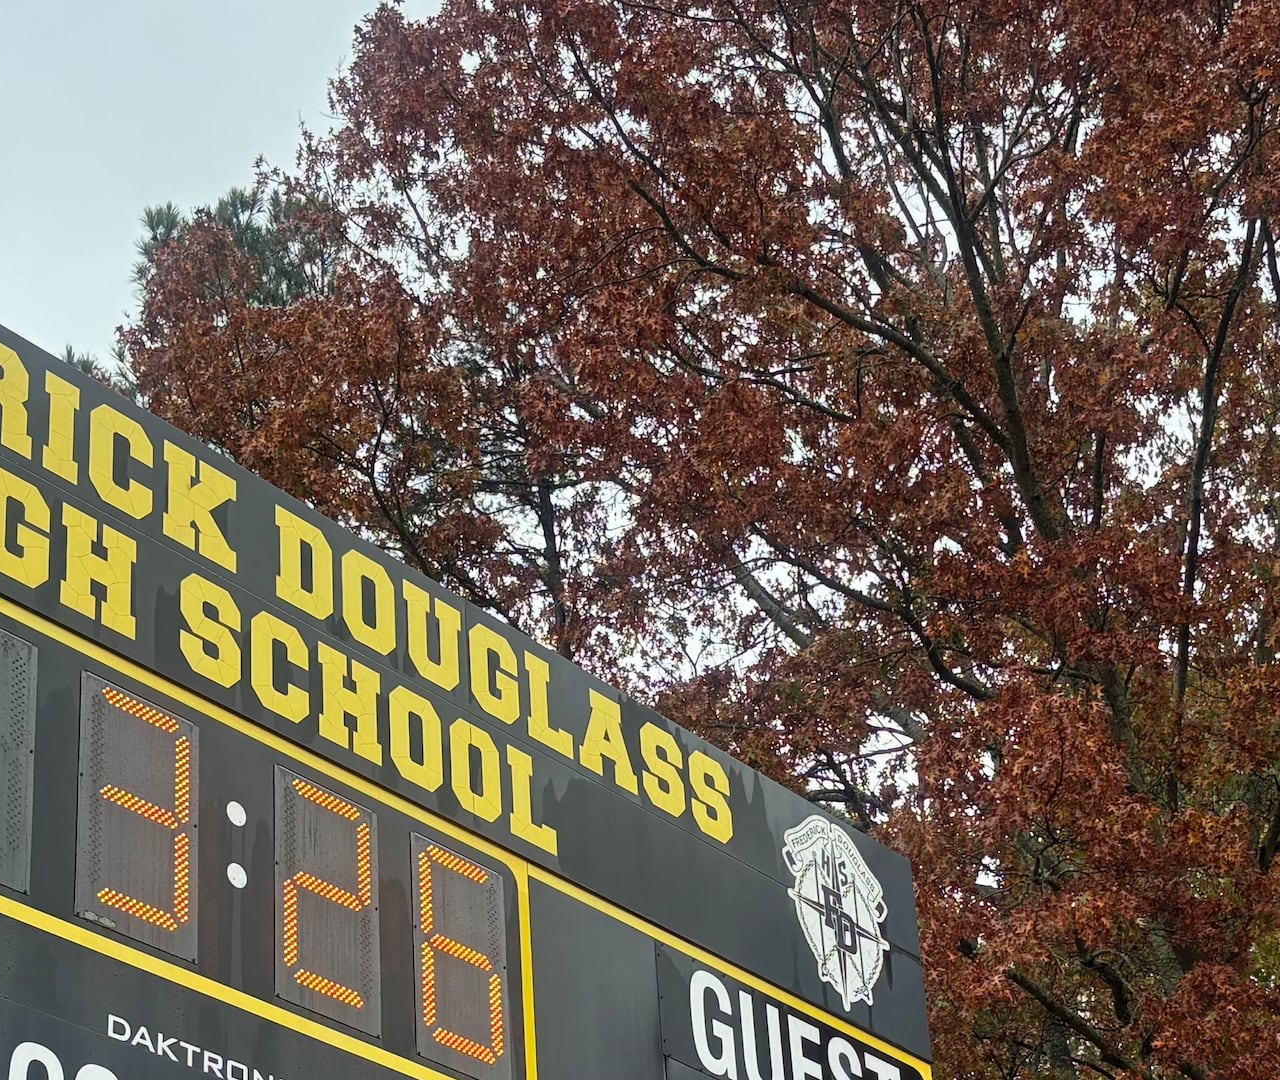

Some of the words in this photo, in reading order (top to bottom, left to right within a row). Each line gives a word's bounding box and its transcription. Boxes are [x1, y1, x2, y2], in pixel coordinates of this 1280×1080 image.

[179, 572, 559, 857] SCHOOL
[275, 507, 734, 845] DOUGLASS
[98, 686, 504, 1066] 3:26
[791, 825, 827, 850] FREDERICK
[836, 834, 876, 894] DOUGLASS
